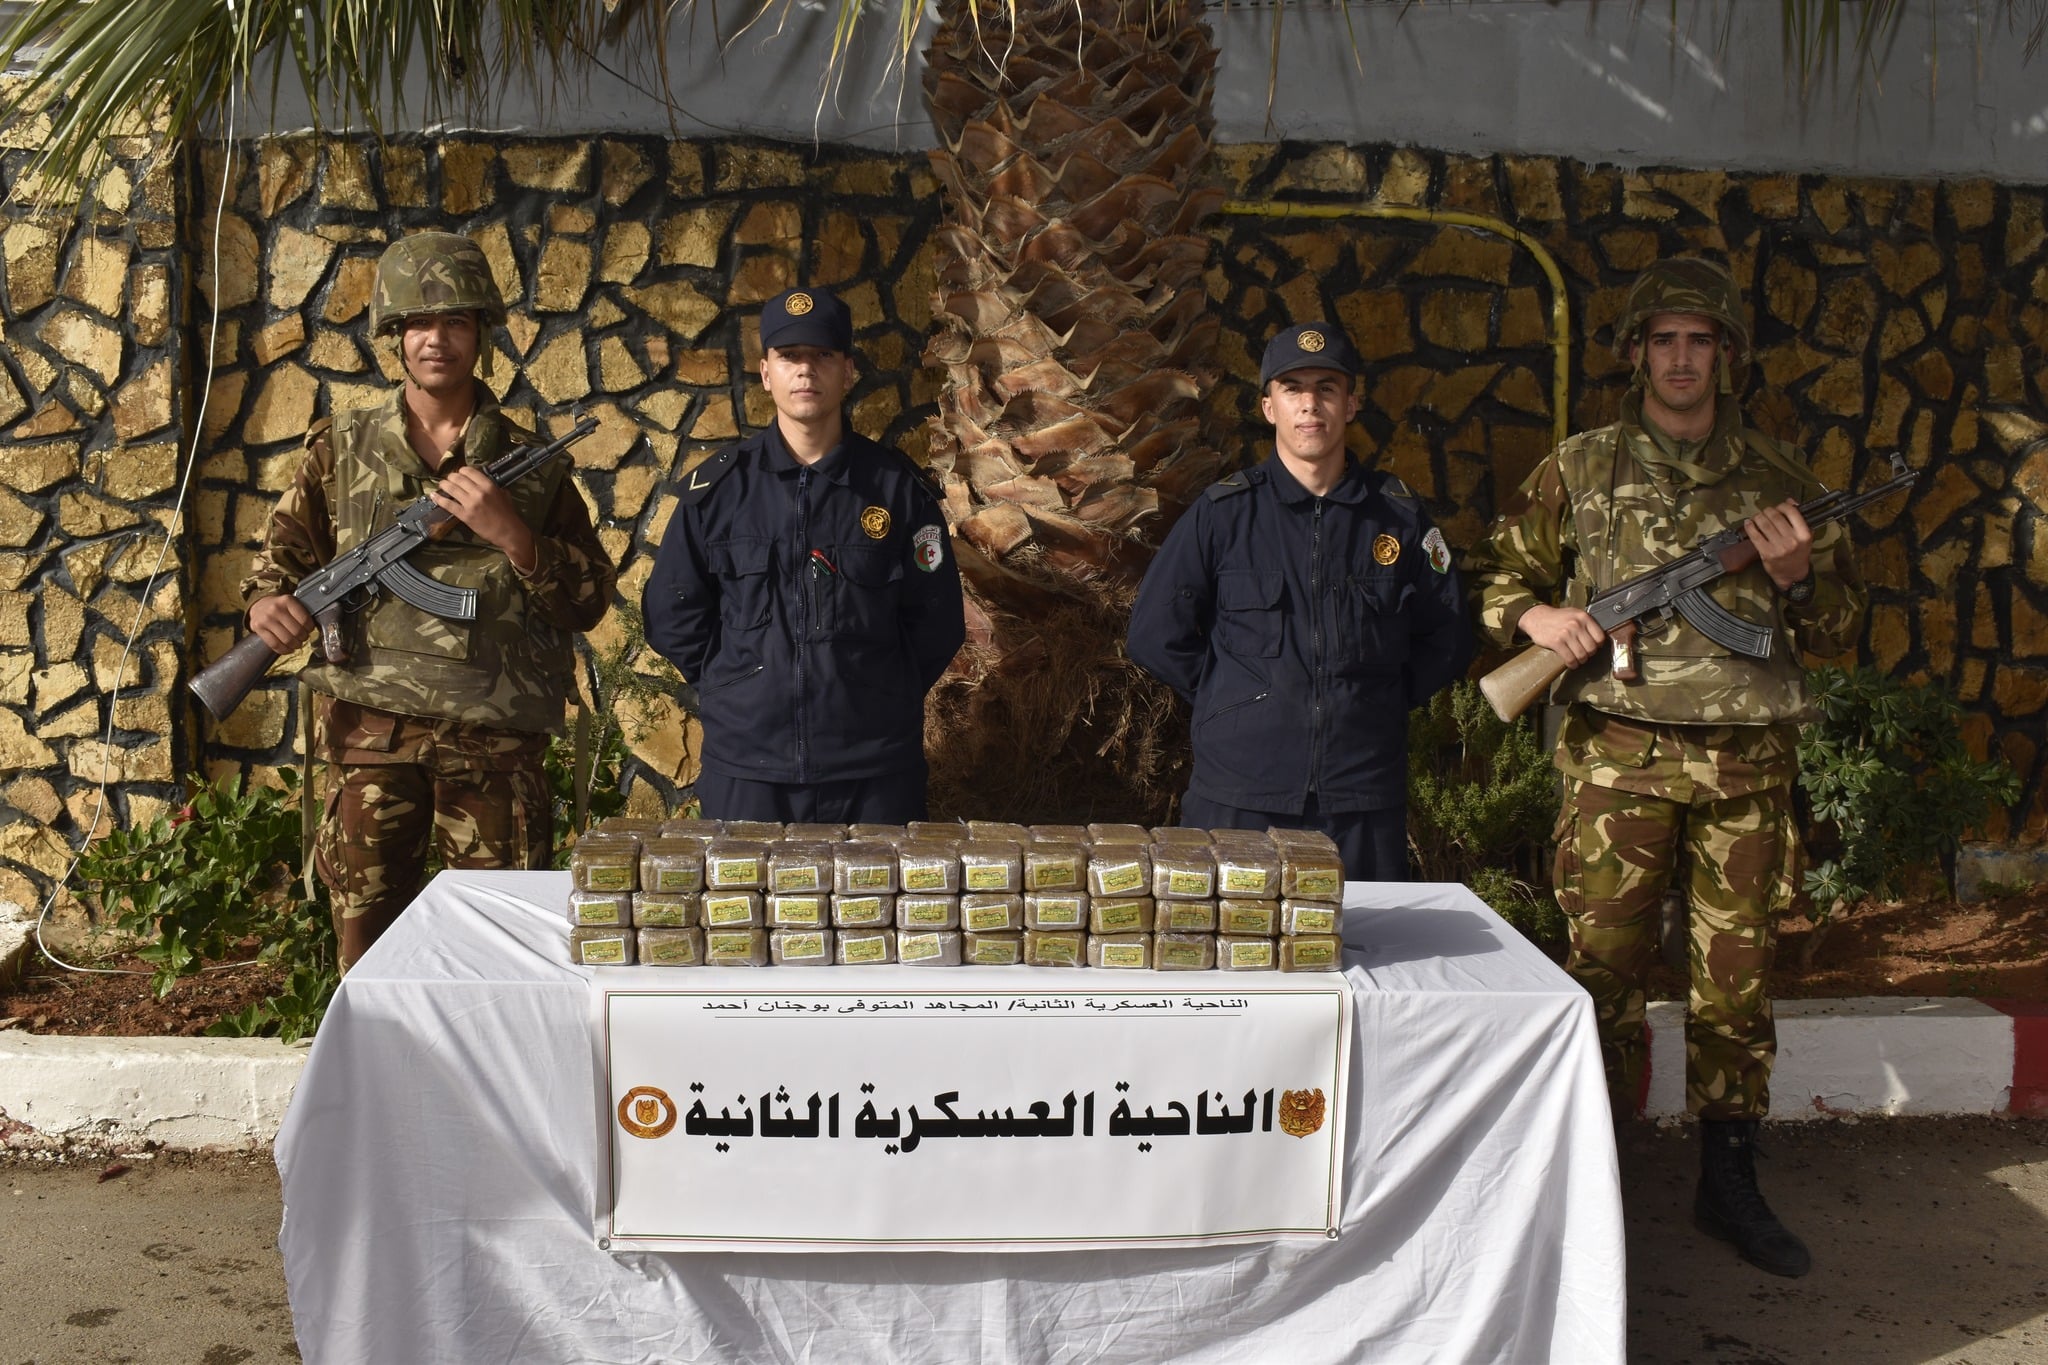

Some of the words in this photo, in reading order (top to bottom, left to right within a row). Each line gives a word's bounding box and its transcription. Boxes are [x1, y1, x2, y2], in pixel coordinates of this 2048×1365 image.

[702, 998, 748, 1010] أحمد
[757, 1000, 830, 1012] بوجنان
[837, 999, 914, 1014] المتوفى
[924, 999, 998, 1012] المجاهد
[1084, 998, 1173, 1013] العسكرية
[1182, 997, 1249, 1011] الناحية
[685, 1081, 839, 1153] الثانية
[855, 1082, 1095, 1155] العسكرية
[1109, 1081, 1274, 1153] الناحية
